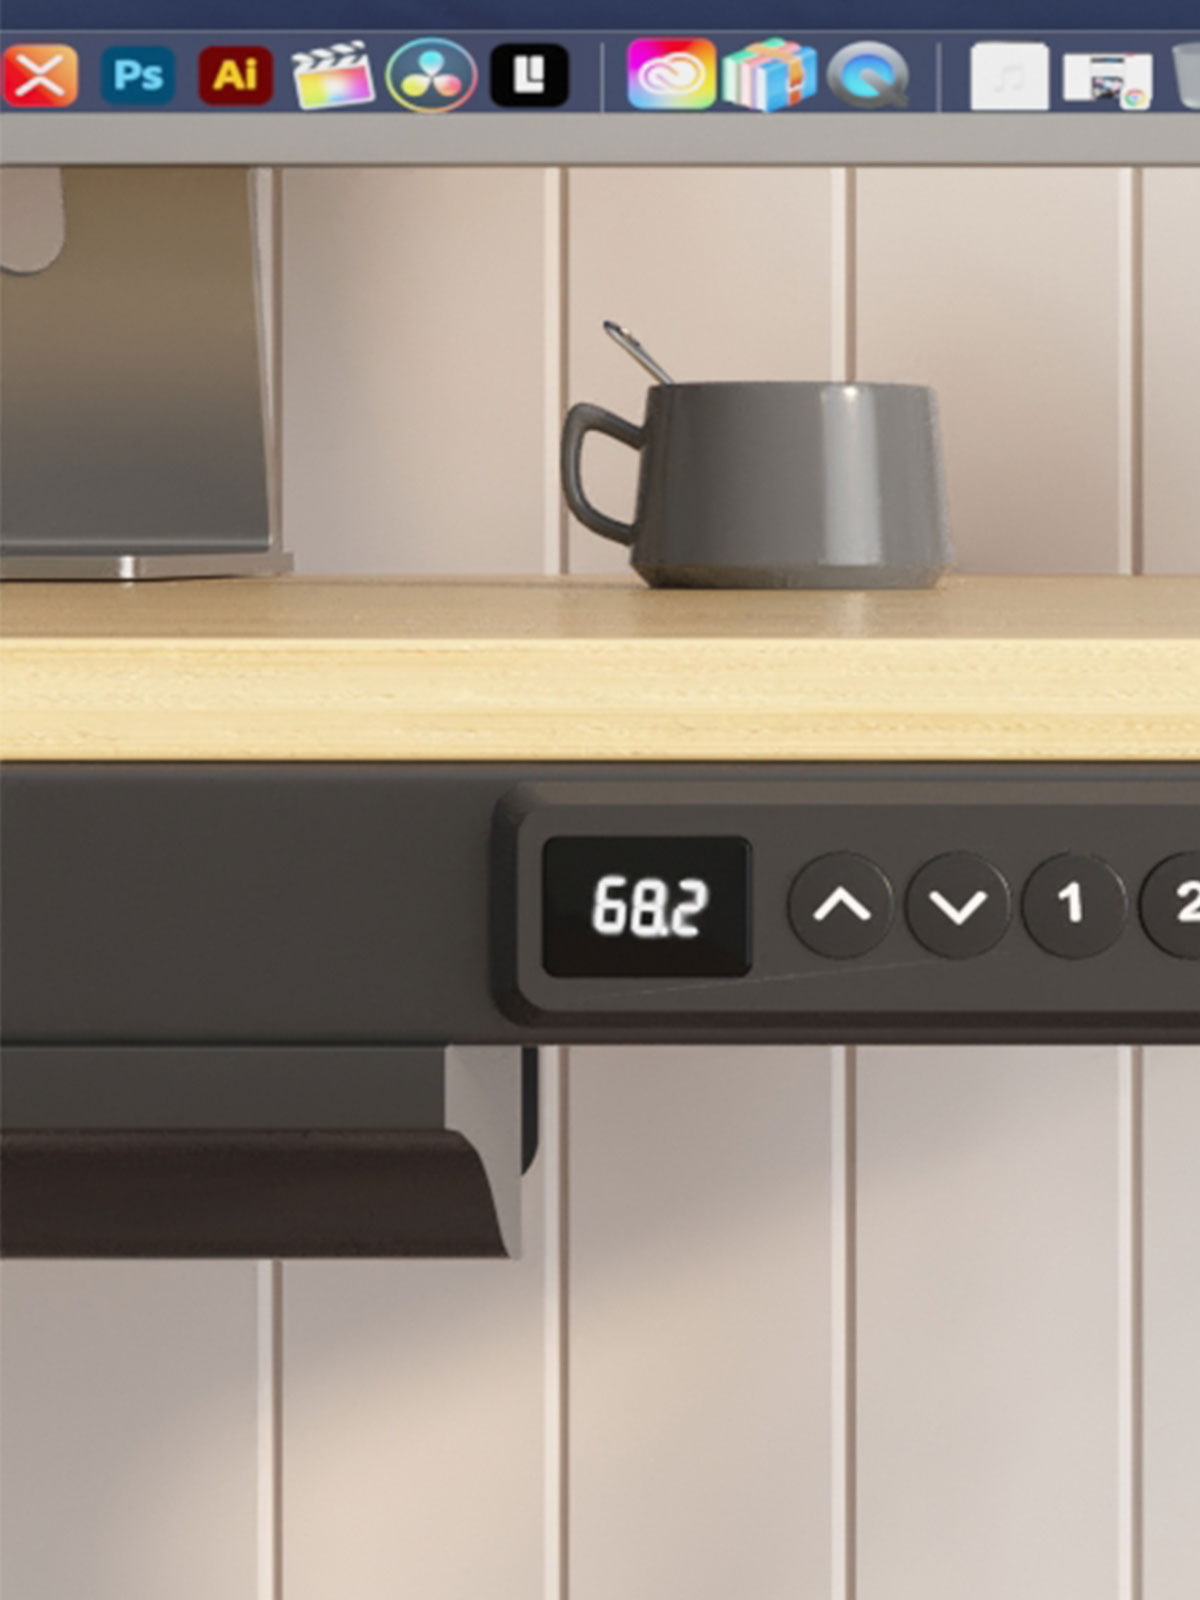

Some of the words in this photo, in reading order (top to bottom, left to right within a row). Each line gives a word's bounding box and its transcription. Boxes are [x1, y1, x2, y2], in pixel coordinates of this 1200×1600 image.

[114, 59, 164, 91] Ps
[212, 57, 258, 90] Ai
[592, 875, 708, 938] 68.2
[1058, 881, 1082, 923] 1
